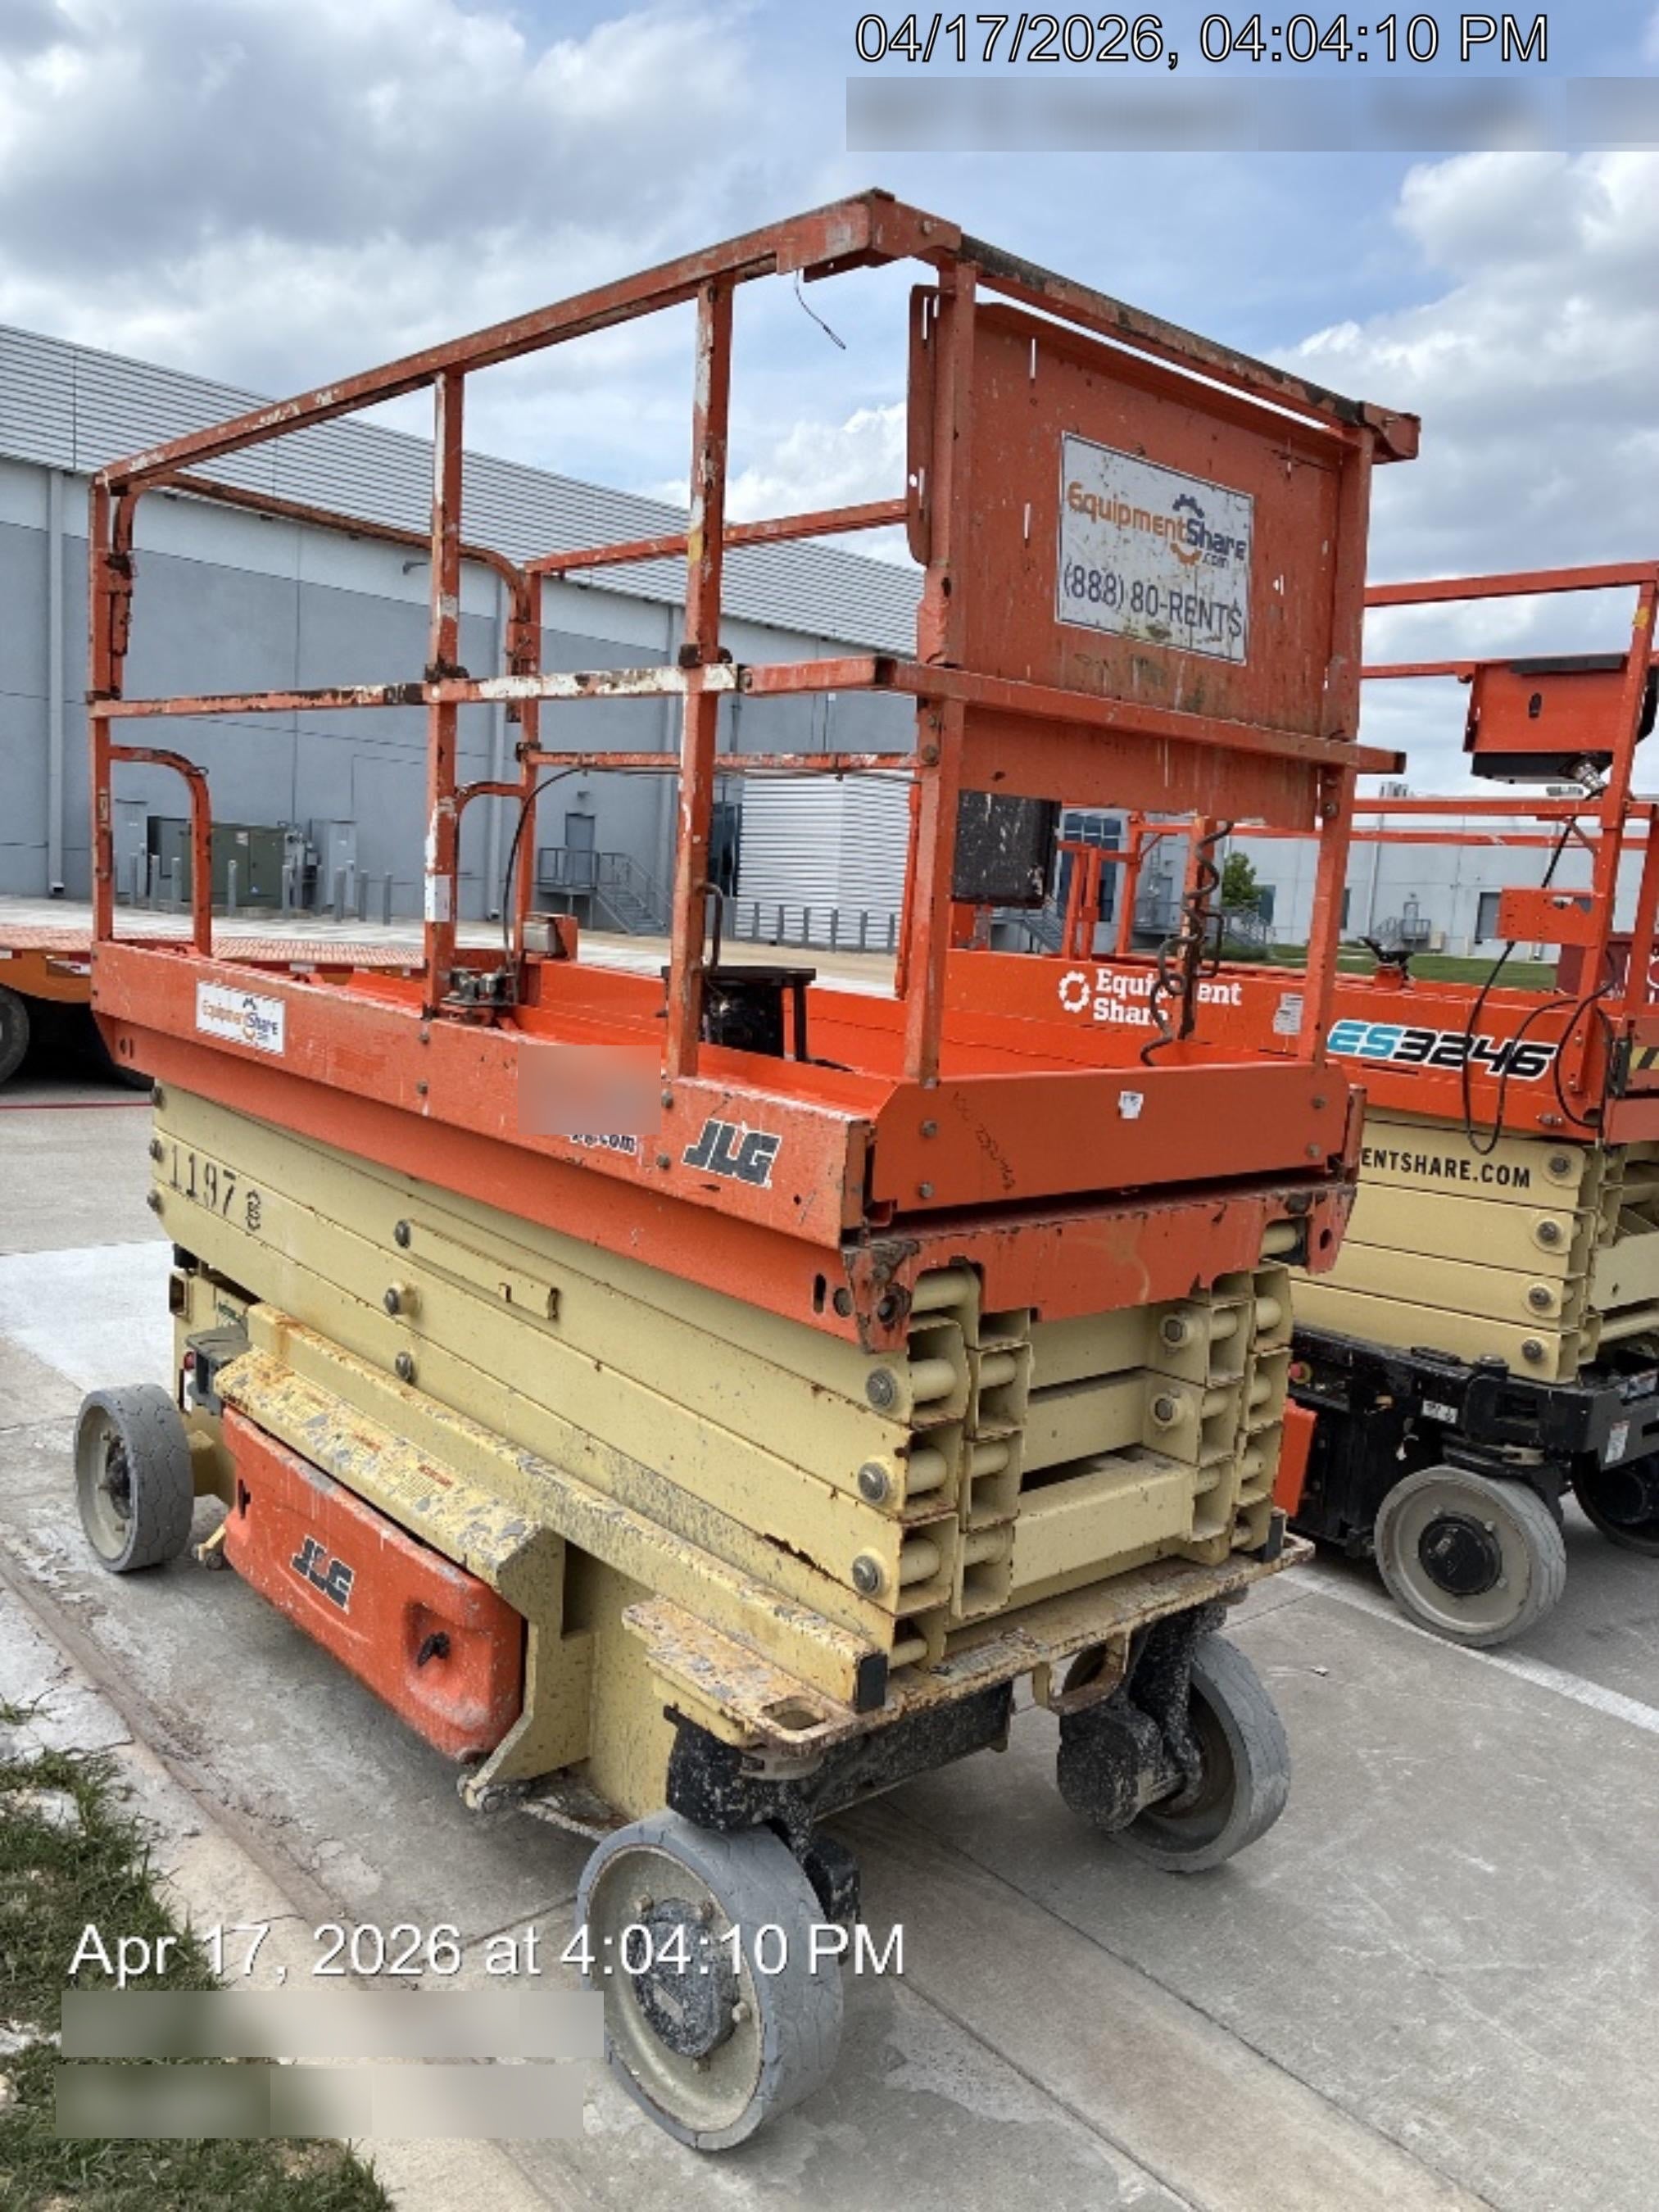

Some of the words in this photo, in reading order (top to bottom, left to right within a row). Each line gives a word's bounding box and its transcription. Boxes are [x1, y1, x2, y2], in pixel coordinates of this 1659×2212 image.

[1067, 481, 1247, 561] EquipmentShare
[1064, 556, 1124, 610] (888)
[1130, 580, 1243, 637] 80-RENTS
[1095, 968, 1243, 1006] Equient
[1326, 1020, 1557, 1081] ES3246
[682, 1119, 782, 1187] JLG
[290, 1534, 356, 1611] JLG
